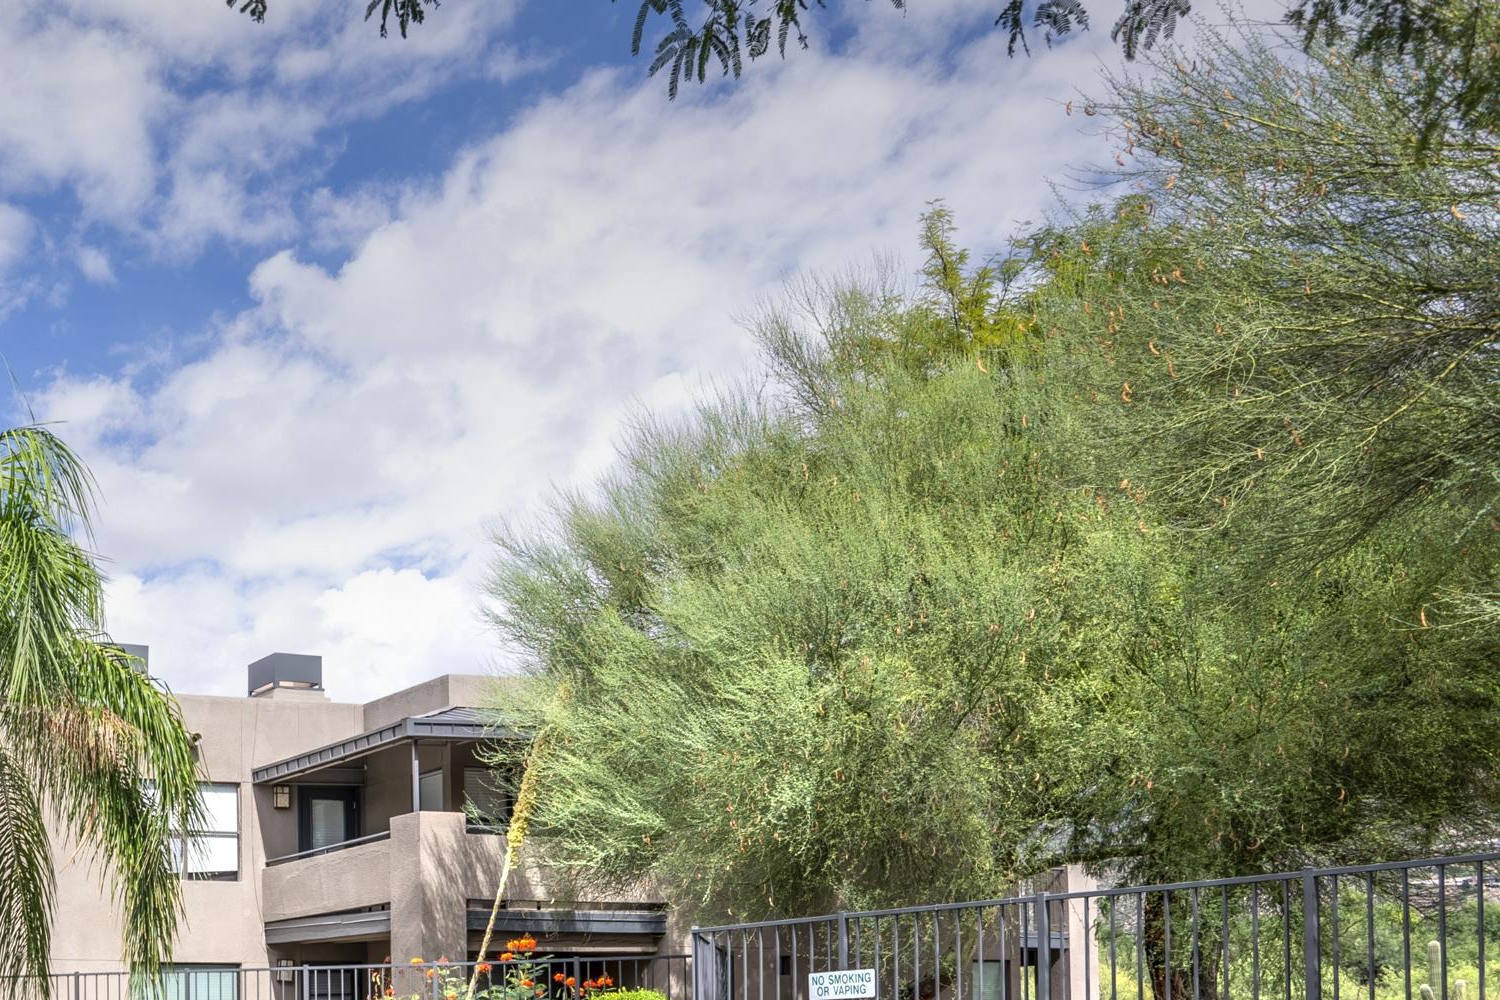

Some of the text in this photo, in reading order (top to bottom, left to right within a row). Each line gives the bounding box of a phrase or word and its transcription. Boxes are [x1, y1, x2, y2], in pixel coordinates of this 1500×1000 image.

[811, 972, 871, 986] NO SMOKING
[816, 984, 867, 997] OR VAPING
